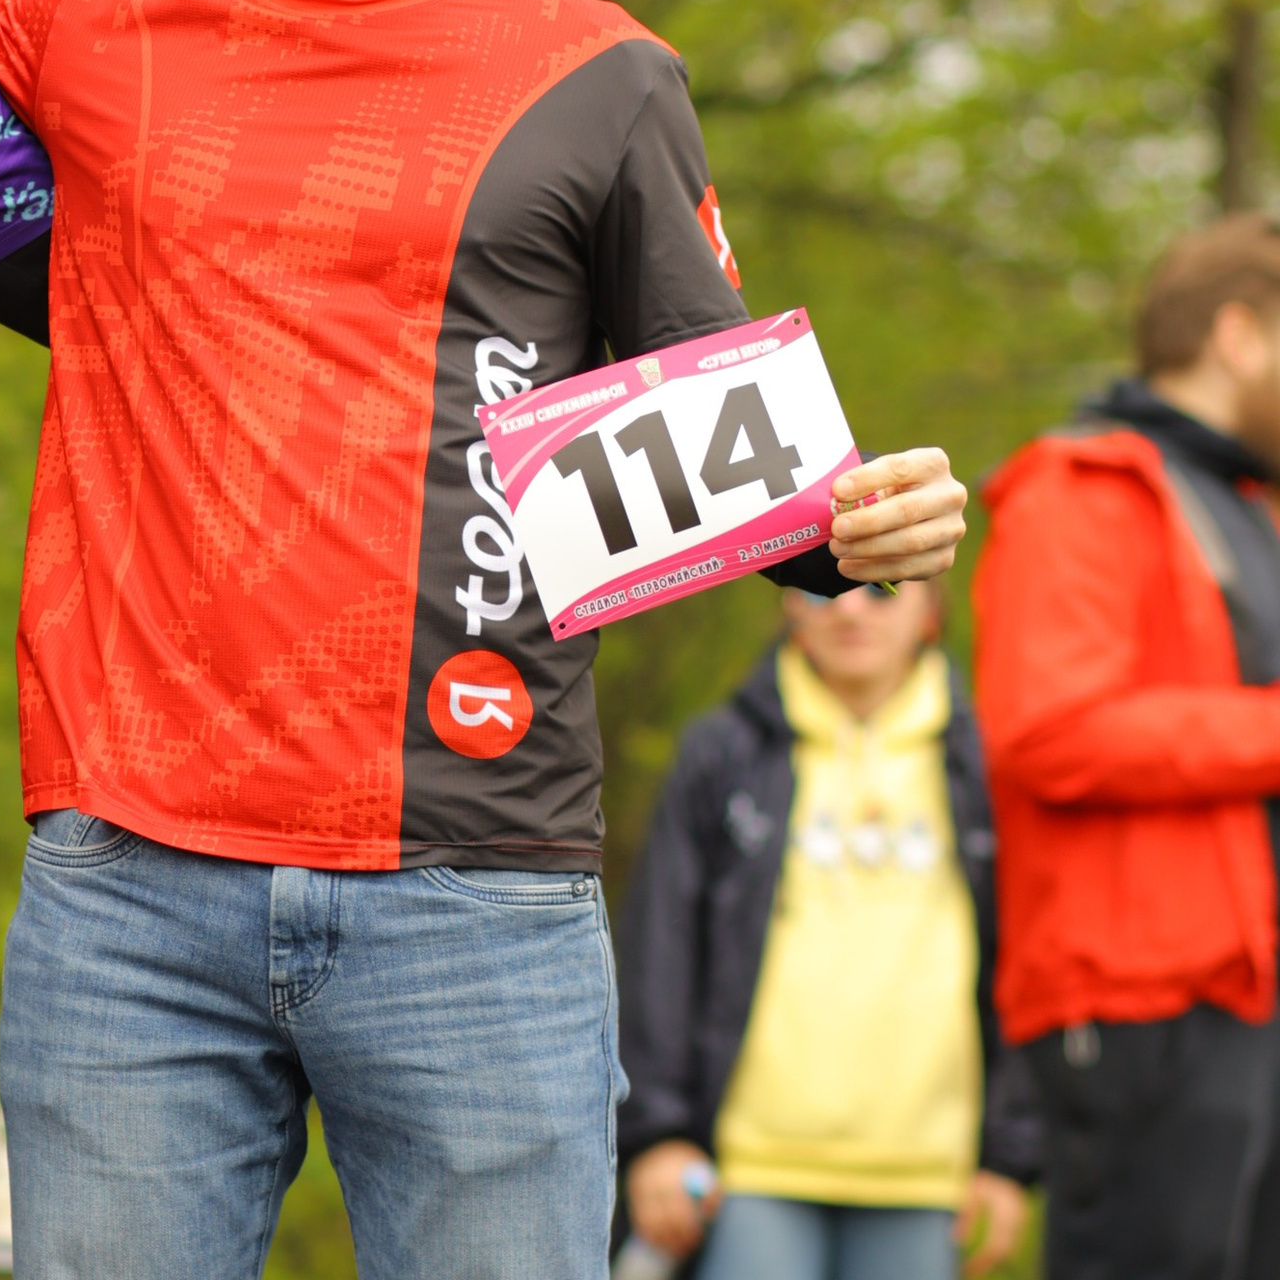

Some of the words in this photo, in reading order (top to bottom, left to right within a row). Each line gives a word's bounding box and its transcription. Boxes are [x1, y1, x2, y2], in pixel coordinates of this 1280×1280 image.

[535, 382, 628, 422] СВЕРХМАРАФОН
[550, 381, 804, 556] 114
[574, 591, 627, 618] СТАДИОН
[628, 556, 726, 600] «ПЕРВОМАЙСКИЙ»
[763, 536, 787, 554] МАЯ
[788, 524, 820, 544] 2025
